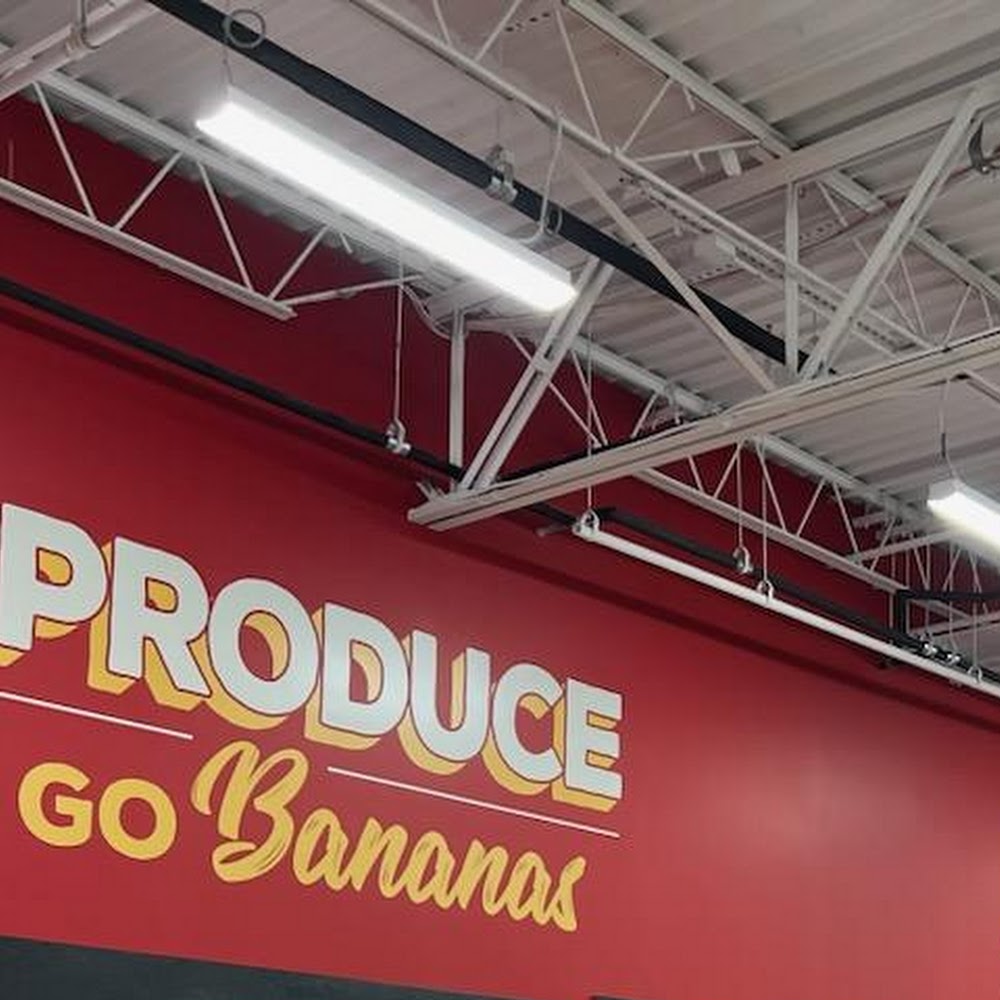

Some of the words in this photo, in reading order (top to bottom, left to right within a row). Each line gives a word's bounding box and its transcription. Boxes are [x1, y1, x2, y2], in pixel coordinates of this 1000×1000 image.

[0, 505, 624, 812] PRODUCE
[18, 763, 177, 860] GO
[190, 740, 587, 932] Bananas
